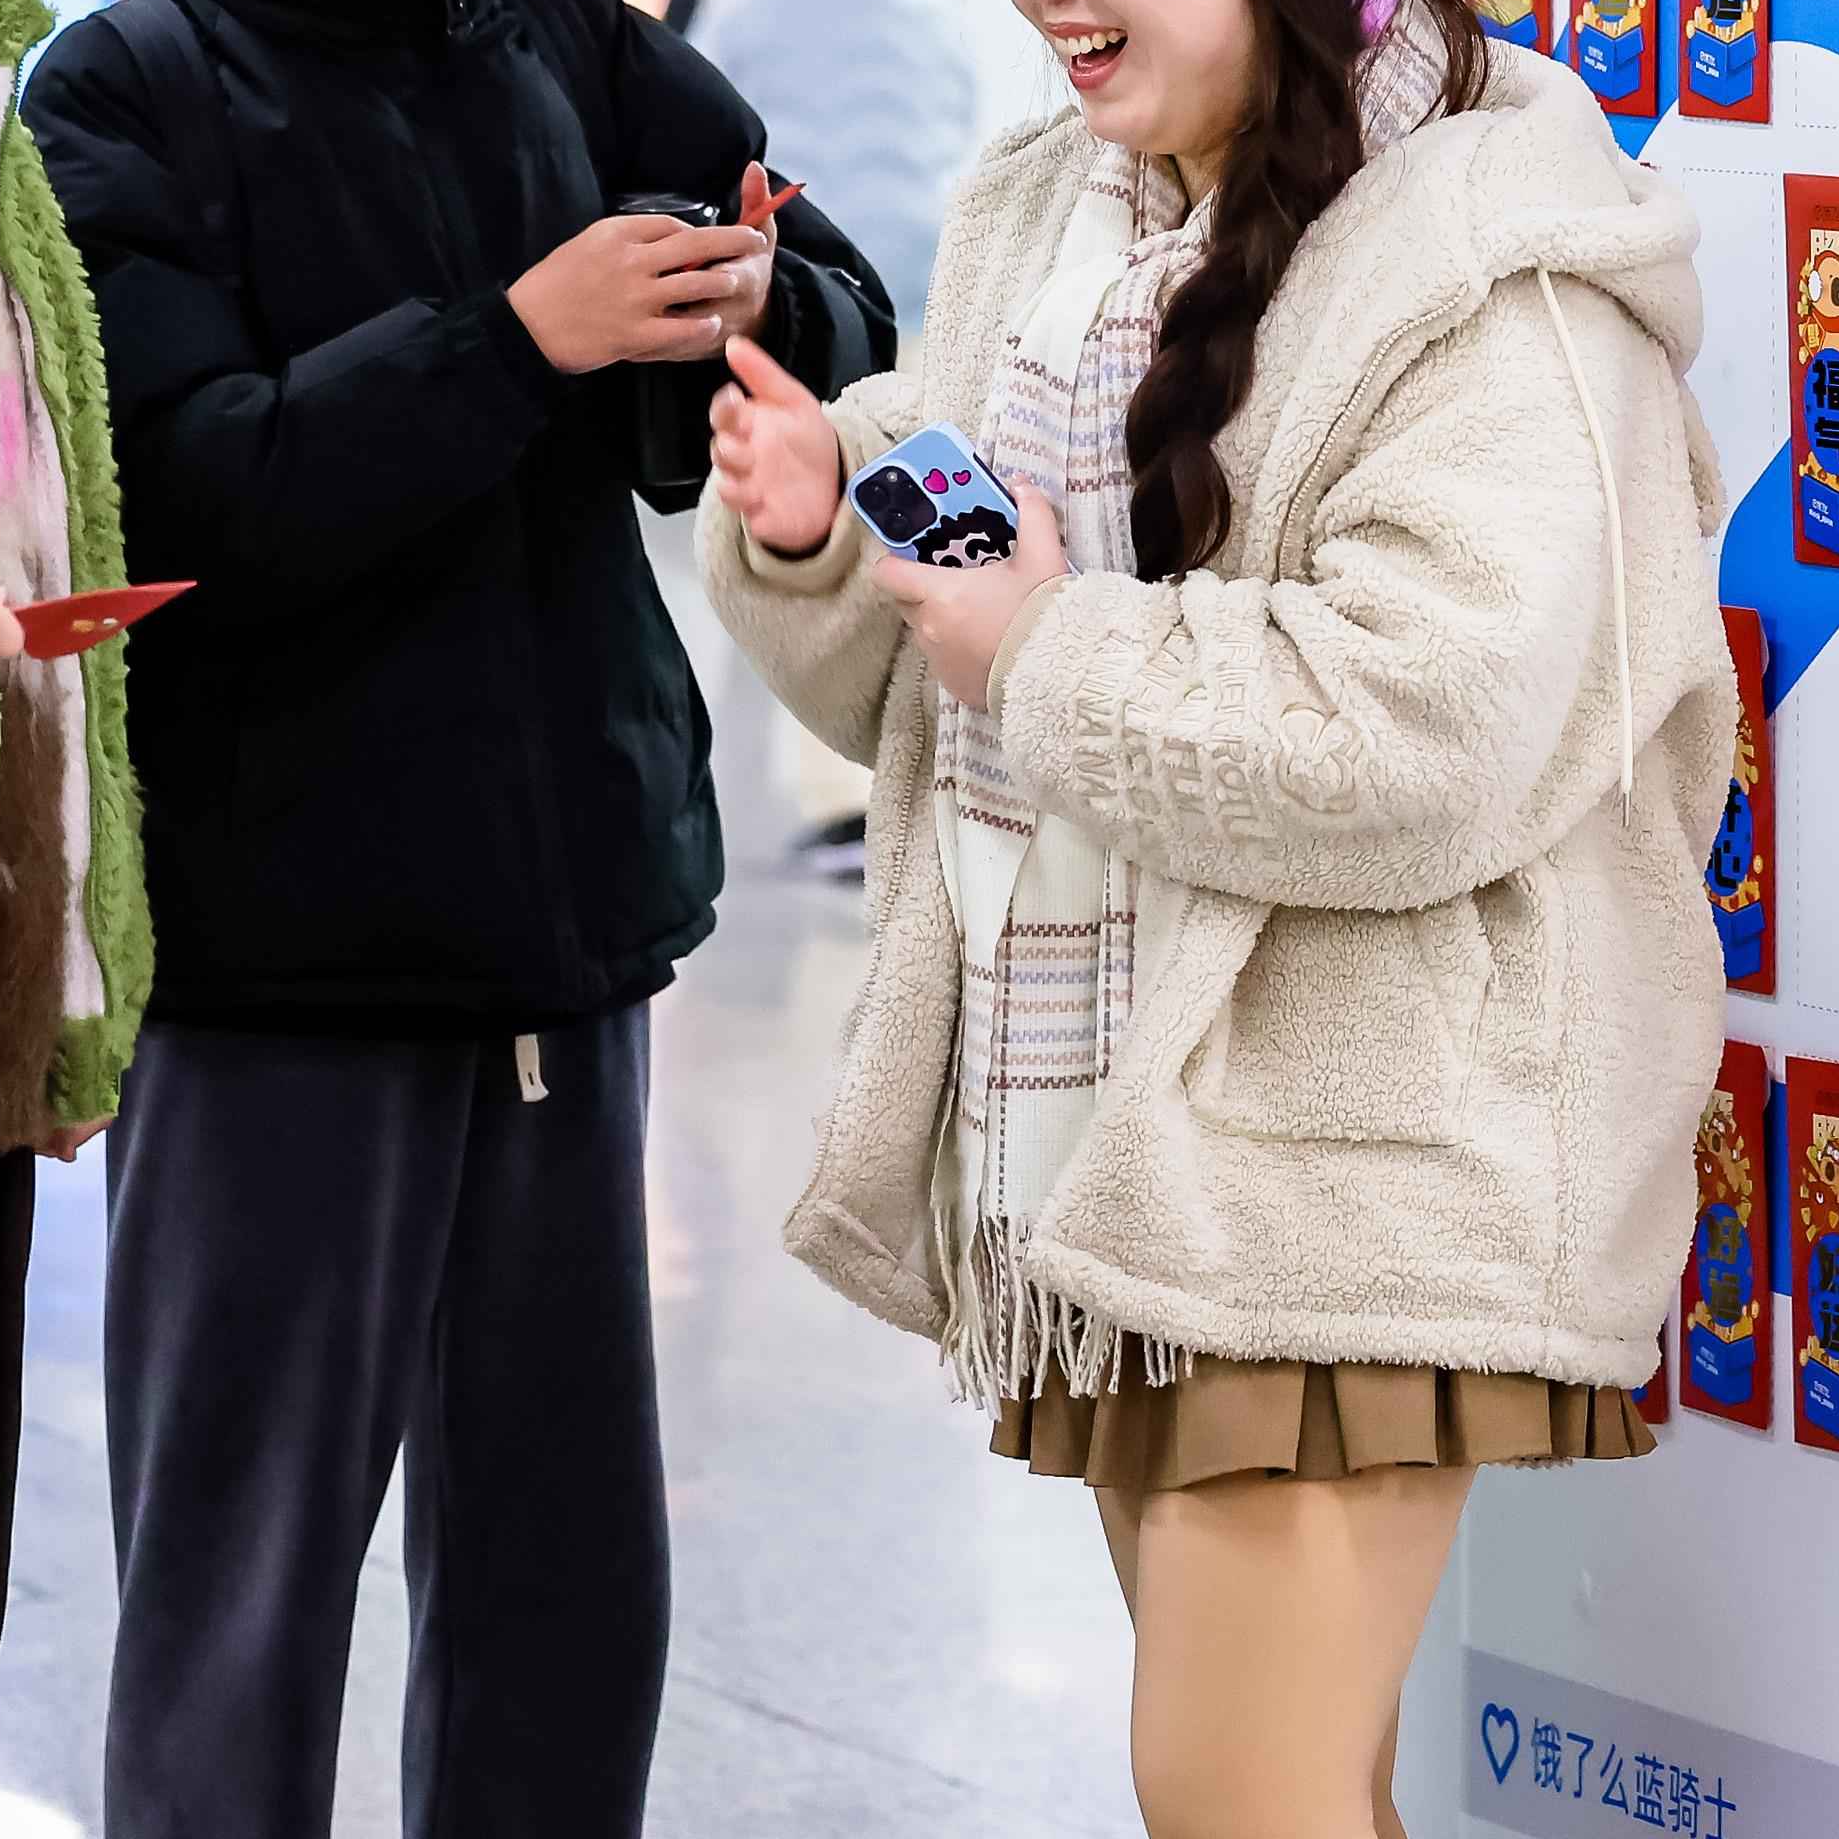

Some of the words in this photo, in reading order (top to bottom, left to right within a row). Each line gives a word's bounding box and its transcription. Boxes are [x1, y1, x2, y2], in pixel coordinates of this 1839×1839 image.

[1531, 1717, 1737, 1839] 饿了么蓝骑士
